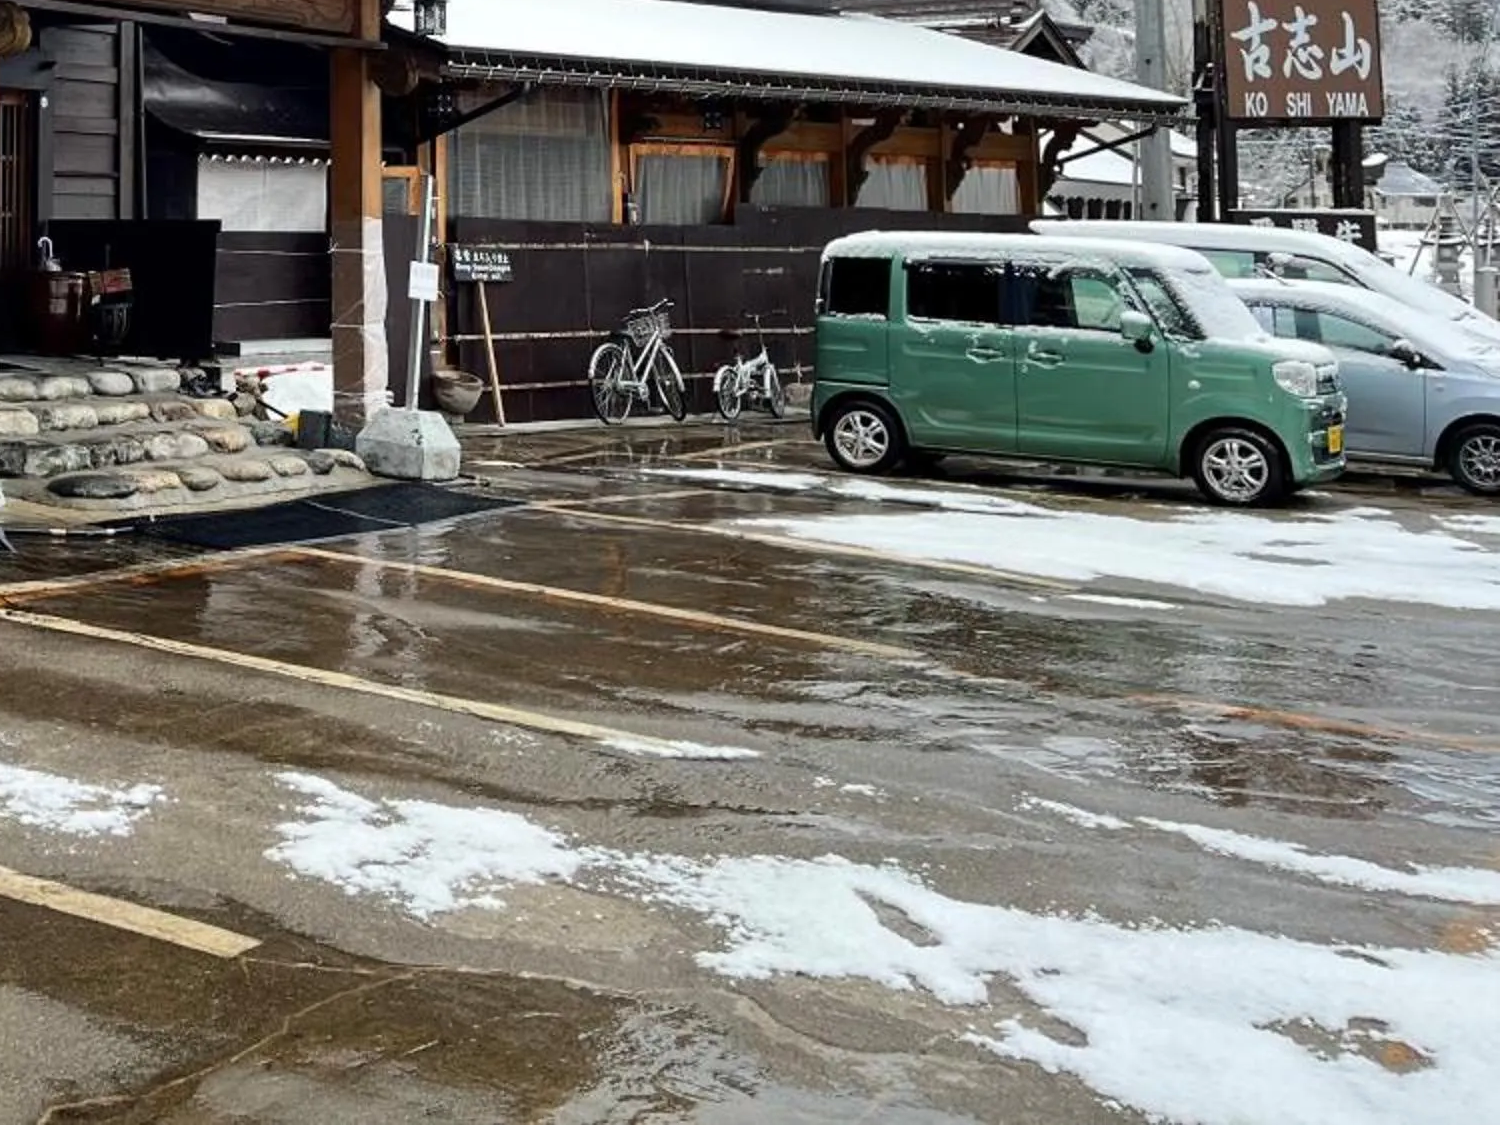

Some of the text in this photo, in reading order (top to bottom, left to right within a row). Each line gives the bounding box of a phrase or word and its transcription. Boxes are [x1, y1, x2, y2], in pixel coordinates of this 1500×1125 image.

[1230, 0, 1373, 83] 古志山
[1244, 91, 1369, 117] KO SHI YAMA
